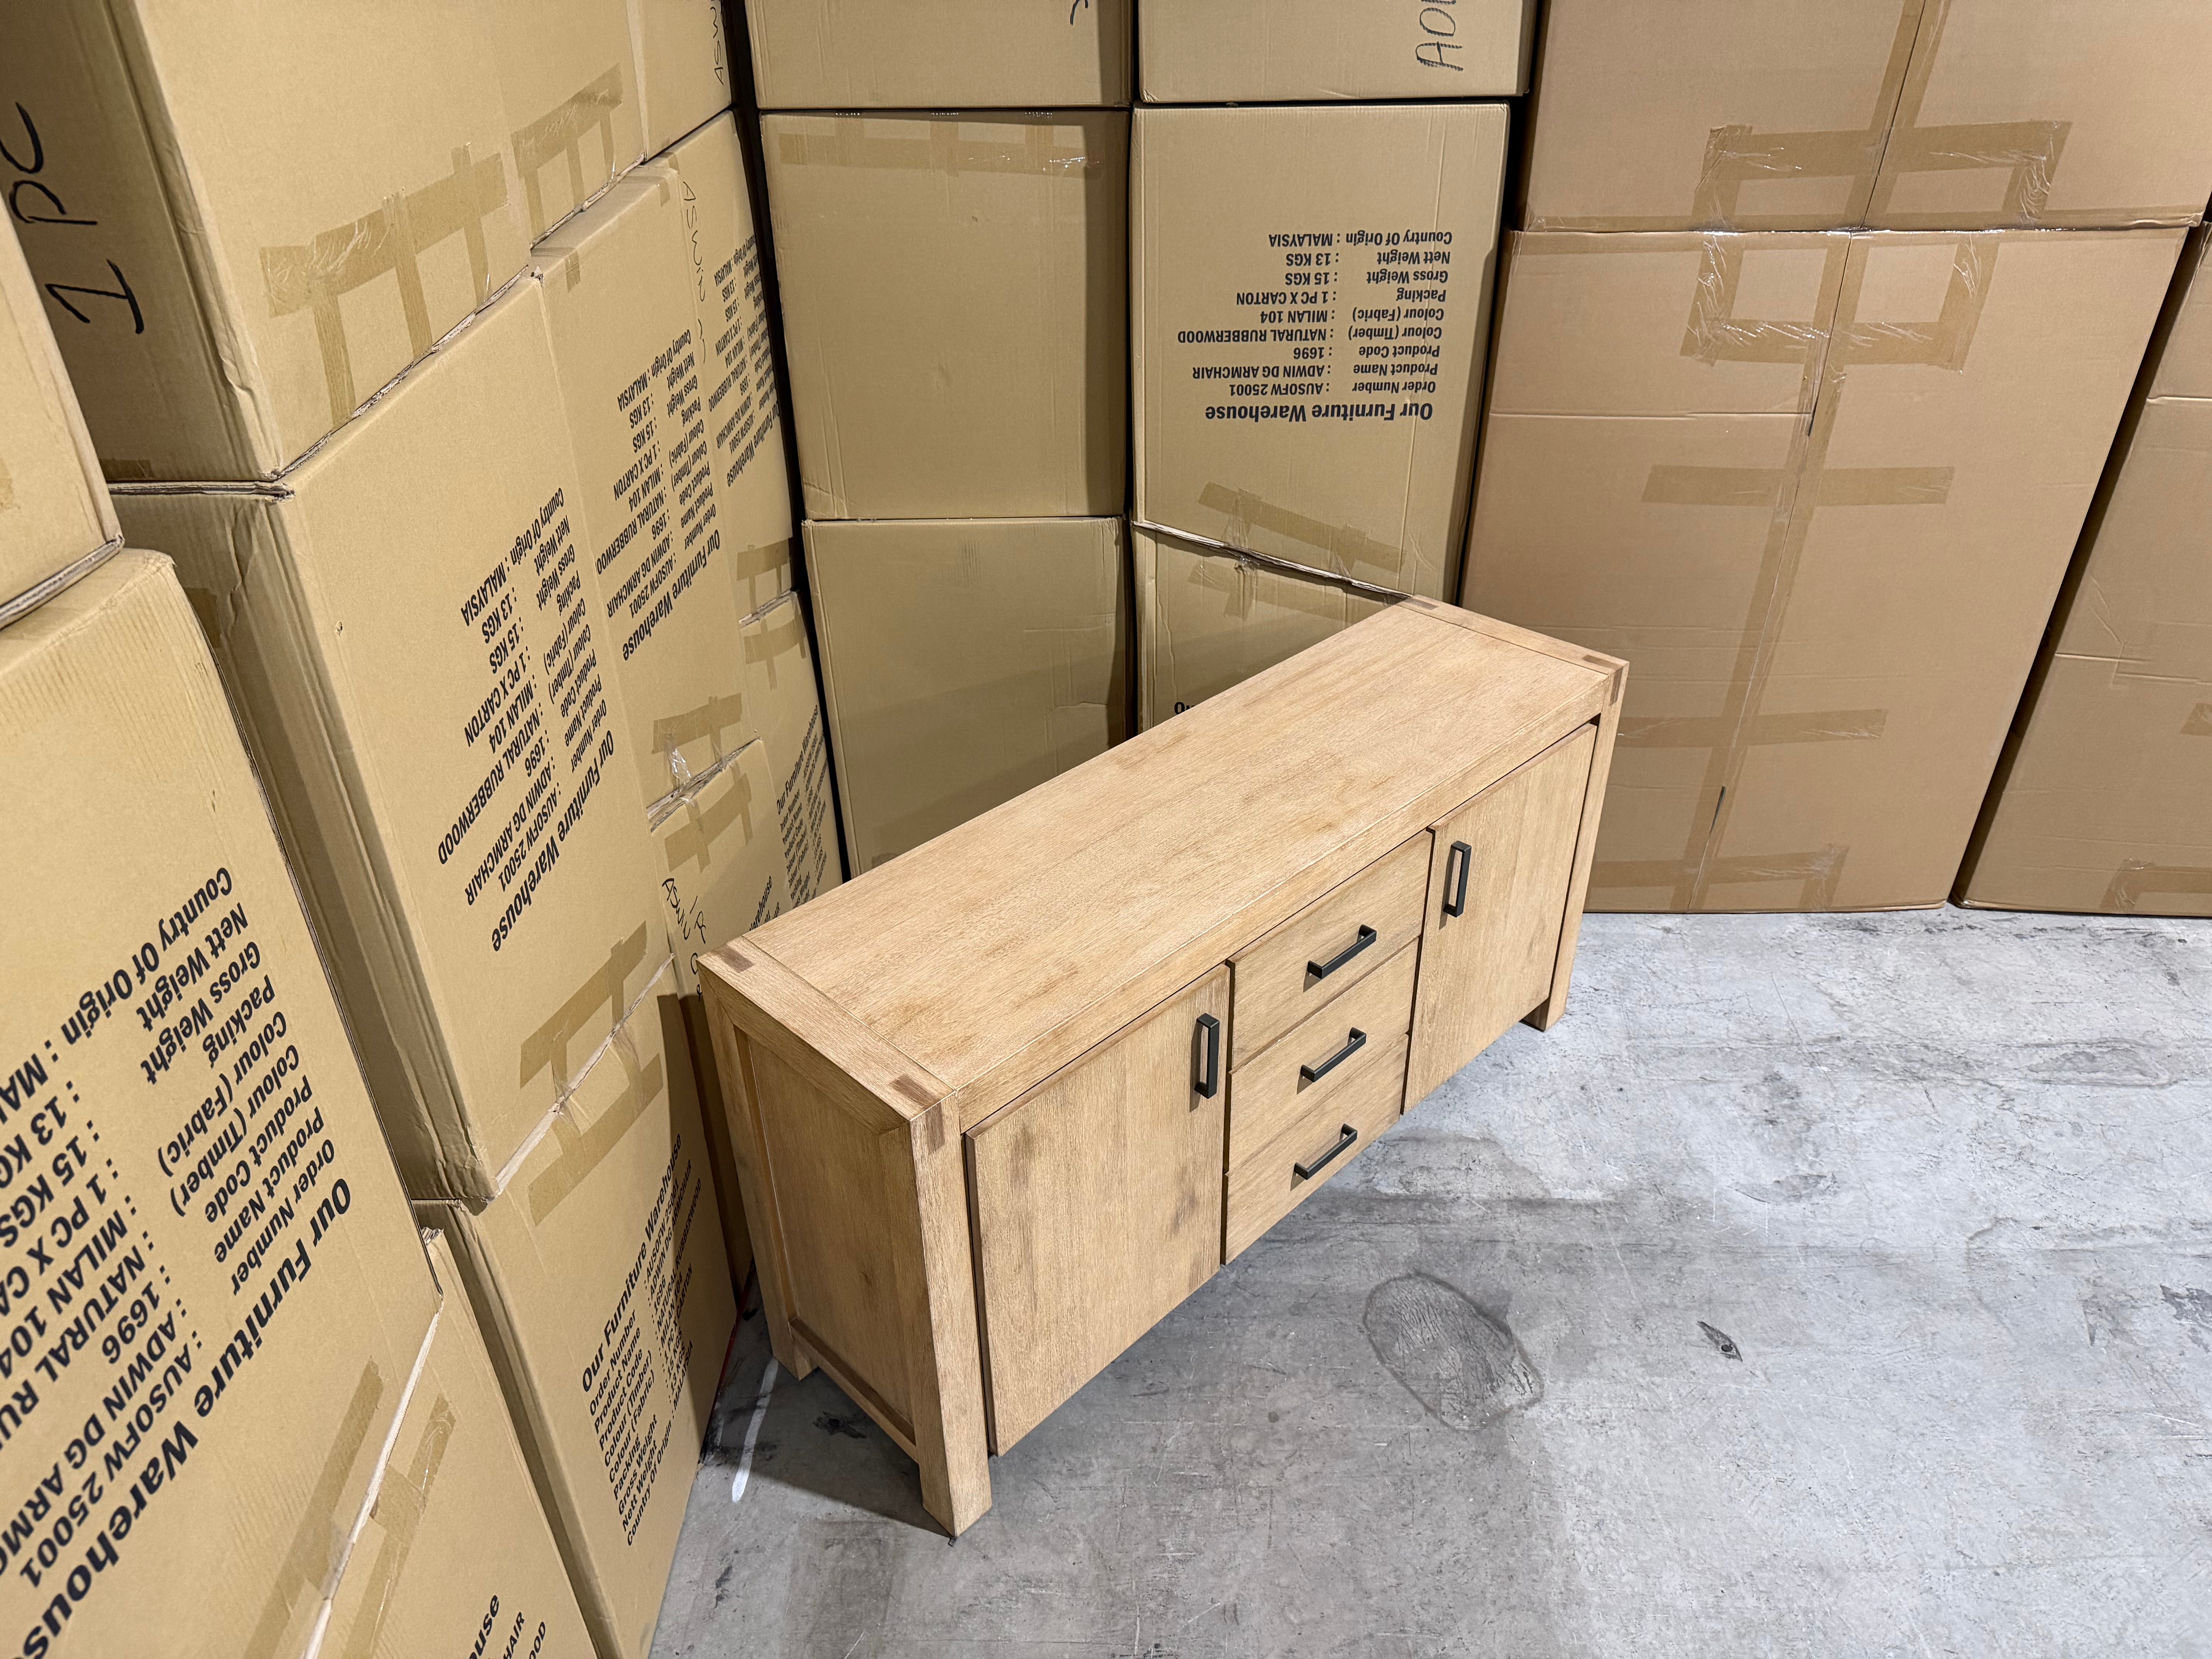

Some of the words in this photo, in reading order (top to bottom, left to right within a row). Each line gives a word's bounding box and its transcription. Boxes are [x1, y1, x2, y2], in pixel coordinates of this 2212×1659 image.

[1415, 0, 1463, 71] AD
[1269, 234, 1333, 247] MALAYSIA
[1346, 230, 1382, 246] Origin
[1385, 232, 1400, 246] Of
[1403, 229, 1452, 245] Country
[1286, 253, 1312, 266] KGS
[1316, 253, 1331, 266] 13
[1377, 249, 1420, 265] Weight
[1423, 251, 1450, 264] Nett
[1285, 273, 1310, 285] KGS
[1314, 272, 1329, 285] 15
[1367, 268, 1409, 284] Weight
[1396, 287, 1446, 302] Packing
[1413, 271, 1448, 283] Gross
[1237, 292, 1286, 305] CARTON
[1290, 292, 1298, 304] X
[1301, 292, 1317, 304] PC
[1322, 291, 1328, 304] 1
[1352, 306, 1401, 322] (Fabric)
[1403, 309, 1444, 321] Colour
[1260, 311, 1283, 323] 104
[1288, 310, 1328, 323] MILAN
[1348, 325, 1399, 340] (Timber)
[1401, 327, 1442, 339] Colour
[672, 329, 691, 356] Country
[1178, 330, 1267, 343] RUBBERWOOD
[1270, 329, 1326, 342] NATURAL
[1293, 347, 1324, 359] 1696
[1359, 346, 1389, 358] Code
[1392, 345, 1440, 357] Product
[651, 353, 667, 378] Origin
[666, 347, 673, 367] Of
[1193, 366, 1259, 379] ARMCHAIR
[1262, 366, 1279, 378] DG
[1283, 365, 1324, 378] ADWIN
[1353, 364, 1388, 376] Name
[1390, 364, 1438, 375] Product
[617, 371, 648, 412] MALAYSIA
[1229, 384, 1268, 396] 25001
[1271, 383, 1323, 395] AUSOFW
[1352, 382, 1400, 394] Number
[1402, 381, 1436, 393] Order
[1205, 405, 1306, 422] Warehouse
[1312, 404, 1395, 421] Furniture
[1400, 403, 1432, 420] Our
[689, 419, 704, 444] Colour
[669, 433, 689, 469] (Fabric)
[629, 487, 641, 512] 104
[641, 467, 661, 499] MILAN
[694, 482, 713, 514] Product
[539, 487, 564, 529] Country
[680, 504, 695, 529] Name
[510, 529, 533, 565] Origin
[532, 519, 541, 545] Of
[651, 533, 670, 568] ADWIN
[707, 529, 720, 557] Our
[558, 544, 575, 576] Gross
[641, 556, 651, 578] DG
[672, 545, 707, 599] Furniture
[460, 562, 507, 627] MALAYSIA
[536, 568, 560, 611] Weight
[556, 570, 581, 617] Packing
[606, 567, 641, 618] ARMCHAIR
[507, 623, 520, 652] 15
[573, 624, 591, 662] Colour
[622, 591, 673, 661] Warehouse
[489, 637, 509, 674] KGS
[519, 652, 526, 673] 1
[499, 675, 509, 700] X
[507, 660, 520, 690] PC
[548, 649, 574, 705] (Timber)
[580, 673, 602, 721] Product
[464, 687, 501, 747] CARTON
[565, 710, 582, 747] Name
[591, 699, 607, 733] Order
[502, 708, 540, 770] NATURAL
[571, 725, 593, 773] Number
[598, 730, 614, 769] Our
[525, 761, 551, 814] ADWIN
[785, 750, 804, 797] Furniture
[438, 759, 505, 865] RUBBERWOOD
[512, 802, 527, 832] DG
[557, 757, 600, 842] Furniture
[526, 787, 557, 852] AUSOFW
[464, 821, 513, 906] ARMCHAIR
[498, 838, 526, 892] 25001
[158, 867, 232, 951] Country
[492, 835, 560, 951] Warehouse
[205, 902, 248, 959] Nett
[132, 942, 159, 985] Of
[210, 941, 260, 1003] Gross
[61, 969, 133, 1045] Origin
[136, 947, 210, 1032] Weight
[203, 974, 275, 1068] Packing
[140, 998, 214, 1085] Weight
[234, 1012, 287, 1085] Colour
[247, 1045, 299, 1119] Colour
[31, 1096, 67, 1145] 13
[158, 1073, 233, 1177] (Fabric)
[248, 1075, 313, 1167] Product
[0, 1134, 33, 1188] KG
[52, 1136, 87, 1187] 15
[170, 1108, 247, 1217] (Timber)
[262, 1106, 324, 1199] Product
[86, 1174, 106, 1205] 1
[293, 1139, 334, 1204] Order
[205, 1160, 251, 1223] Code
[0, 1174, 54, 1247] KGS
[51, 1195, 90, 1248] PC
[215, 1189, 266, 1263] Name
[310, 1178, 350, 1247] Our
[26, 1236, 54, 1276] X
[46, 1210, 127, 1315] MILAN
[231, 1197, 295, 1296] Number
[582, 1342, 604, 1393] Our
[604, 1242, 647, 1348] Furniture
[645, 1133, 681, 1242] Warehouse
[34, 1245, 145, 1382] NATURAL
[590, 1368, 610, 1416] Order
[610, 1309, 635, 1372] Number
[646, 1217, 666, 1284] AUSOFW
[665, 1177, 679, 1224] 25001
[102, 1281, 160, 1364] 1696
[194, 1238, 311, 1417] Furniture
[605, 1413, 627, 1467] Colour
[627, 1350, 652, 1417] (Timber)
[657, 1268, 677, 1333] NATURAL
[675, 1178, 701, 1271] RUBBERWOOD
[103, 1311, 176, 1421] ADWIN
[599, 1386, 627, 1452] Product
[626, 1348, 642, 1388] Code
[654, 1274, 666, 1316] 1696
[104, 1343, 191, 1482] AUSOFW
[64, 1413, 105, 1469] DG
[20, 1471, 103, 1587] 25001
[23, 1420, 198, 1659] Warehous
